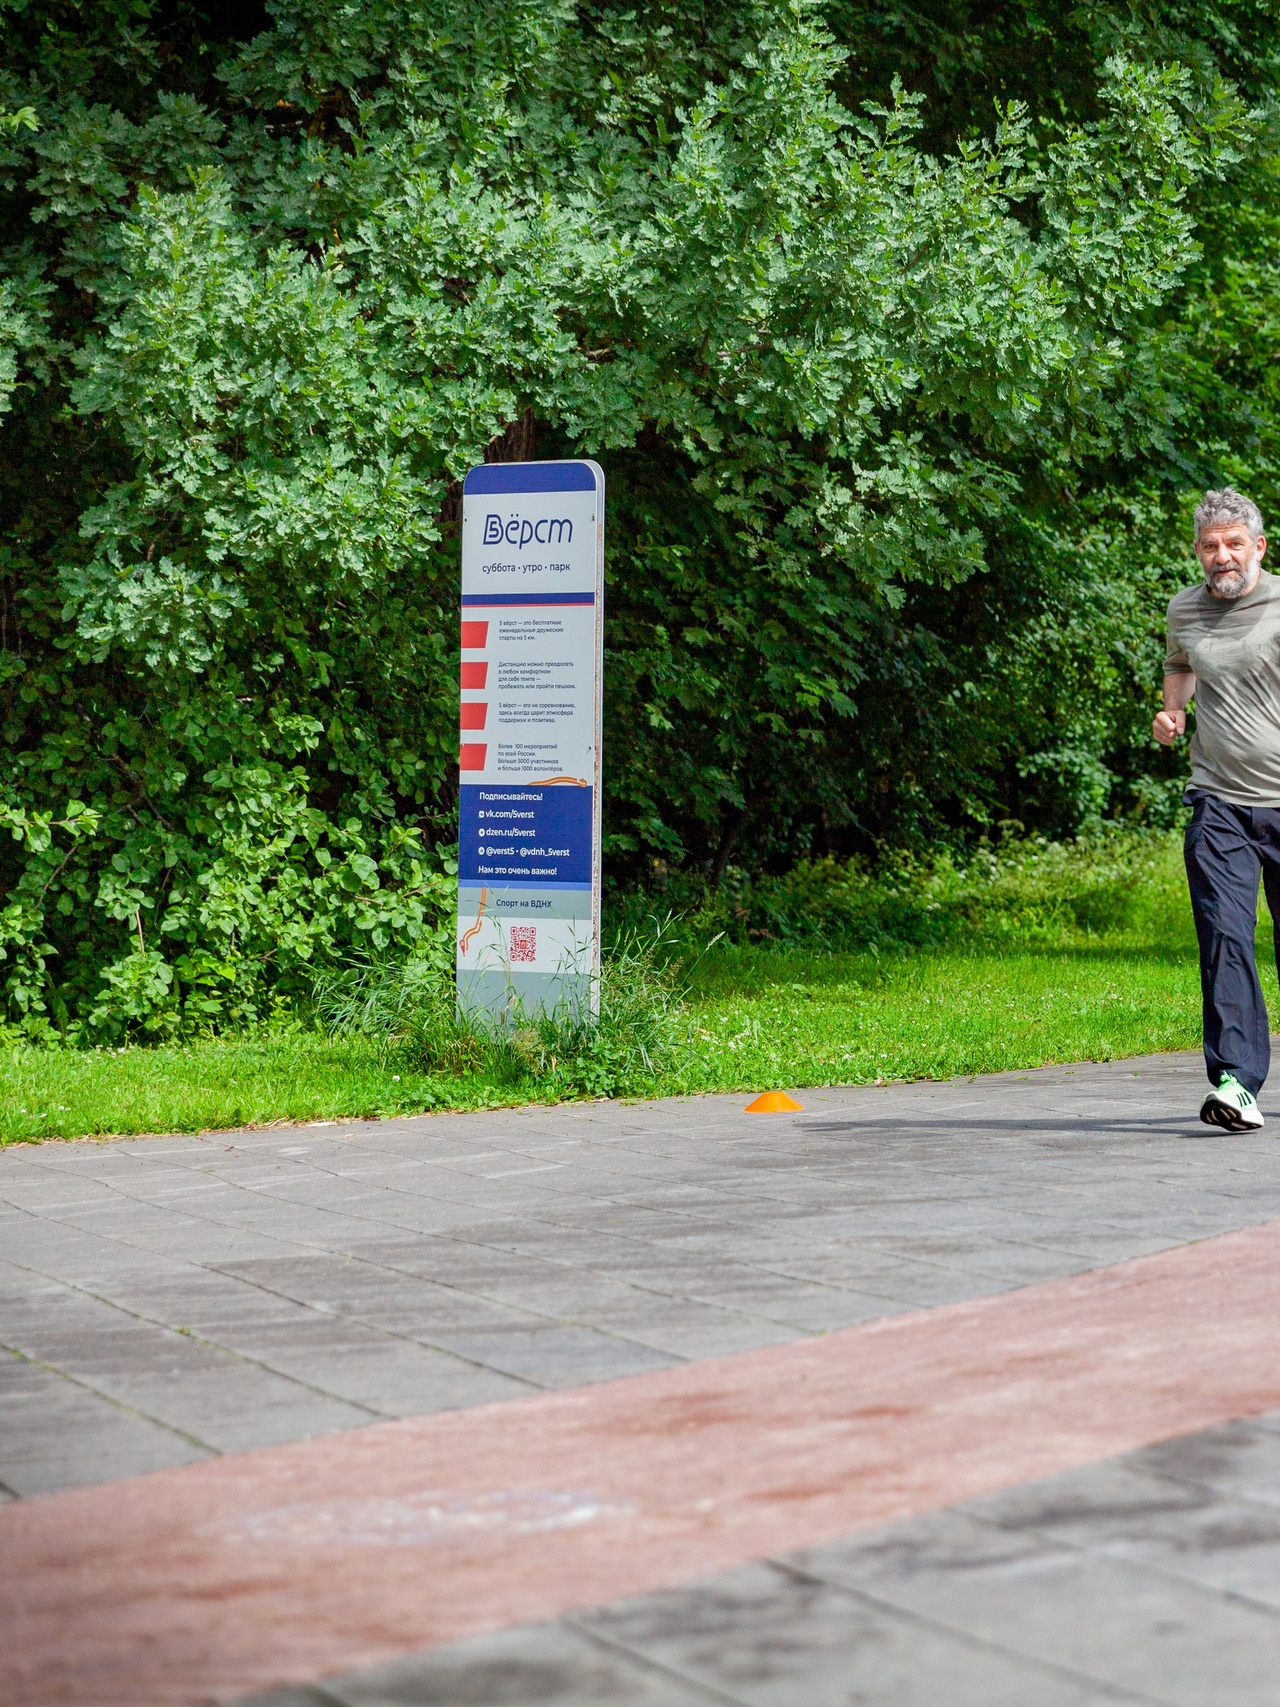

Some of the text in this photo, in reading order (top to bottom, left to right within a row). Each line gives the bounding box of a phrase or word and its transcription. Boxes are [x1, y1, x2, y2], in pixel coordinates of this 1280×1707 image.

[482, 562, 571, 574] суббота утро парк
[479, 792, 543, 801] Подписывайтесь!
[485, 809, 535, 819] vk.com/5verst
[486, 827, 536, 837] dzen.ru/5verst
[486, 846, 570, 857] @verst5 @vdnh_5verst
[478, 866, 494, 874] Нам
[508, 867, 530, 875] очень
[531, 867, 558, 875] важно!
[496, 899, 518, 908] Спорт
[531, 900, 552, 908] ВДНХ
